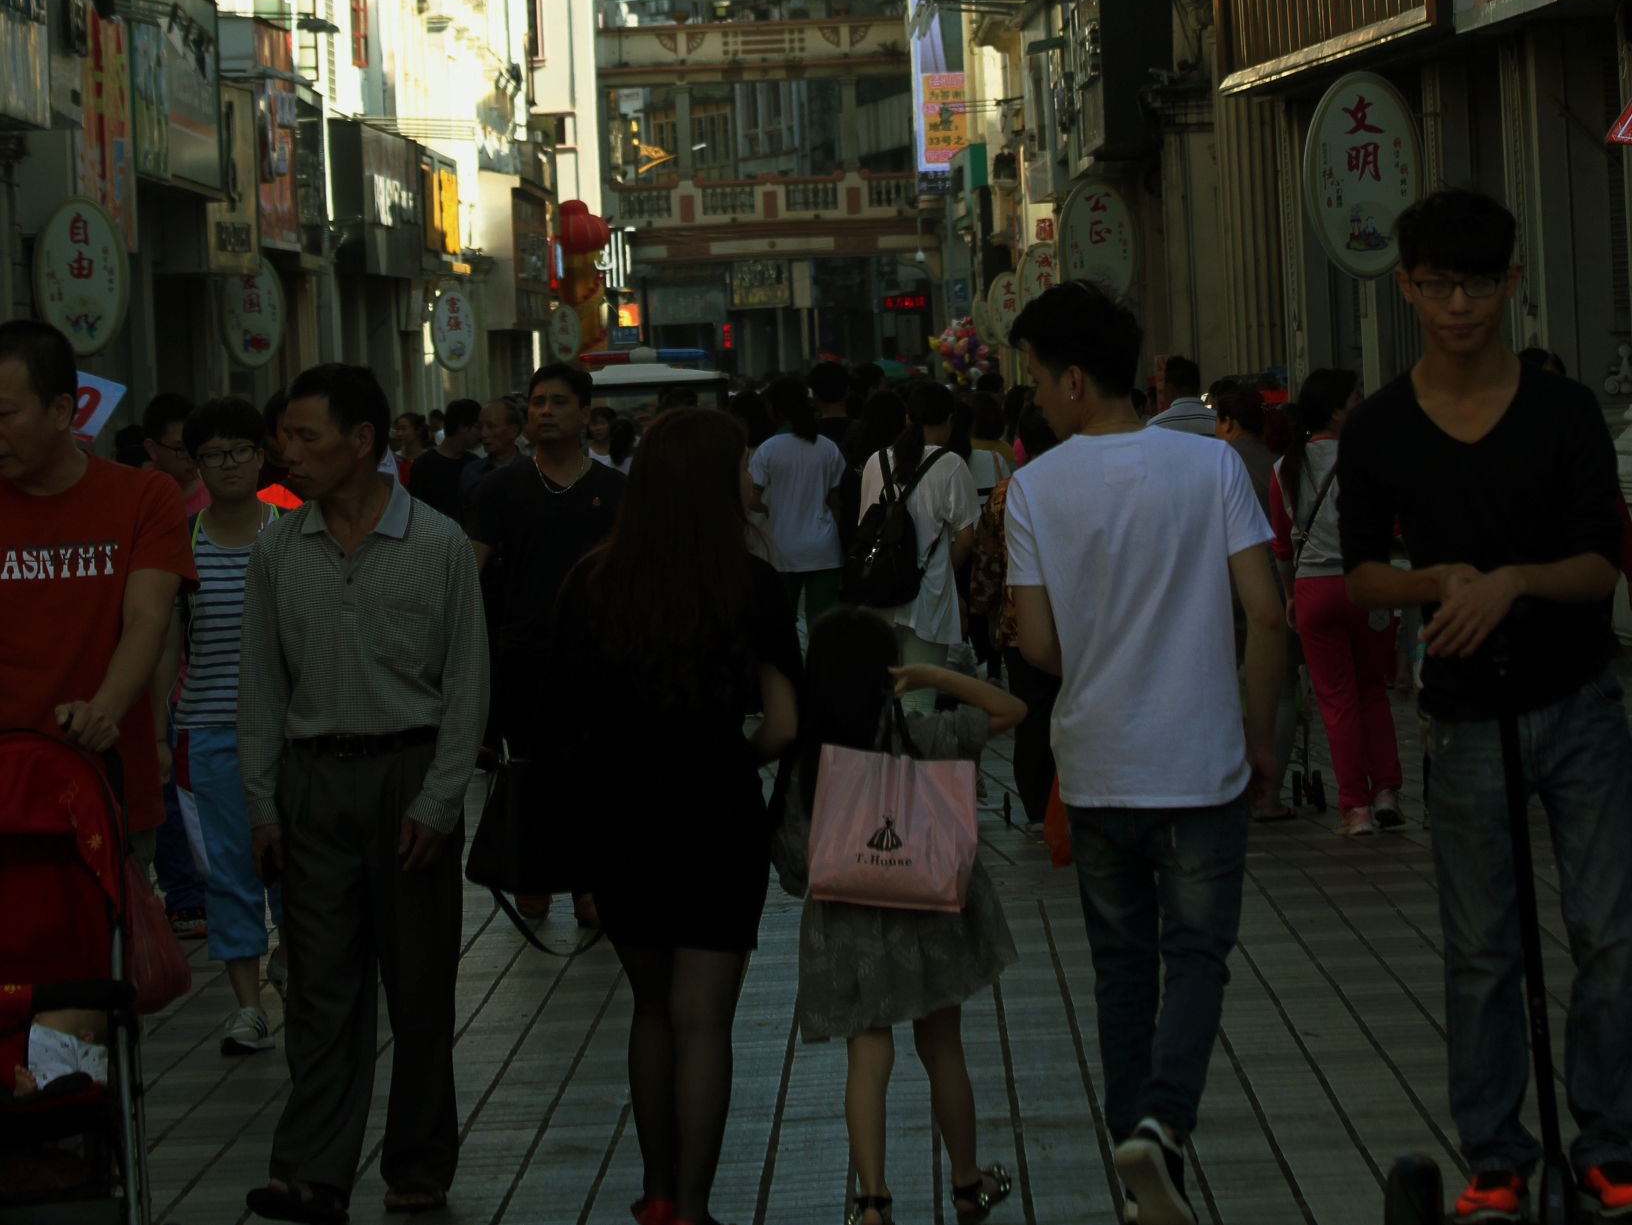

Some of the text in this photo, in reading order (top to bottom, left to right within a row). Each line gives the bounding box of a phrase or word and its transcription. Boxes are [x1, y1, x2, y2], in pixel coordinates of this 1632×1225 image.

[1341, 94, 1384, 182] 文明
[68, 212, 94, 280] 自由
[1085, 191, 1112, 245] 公正
[1035, 253, 1053, 289] 诚信
